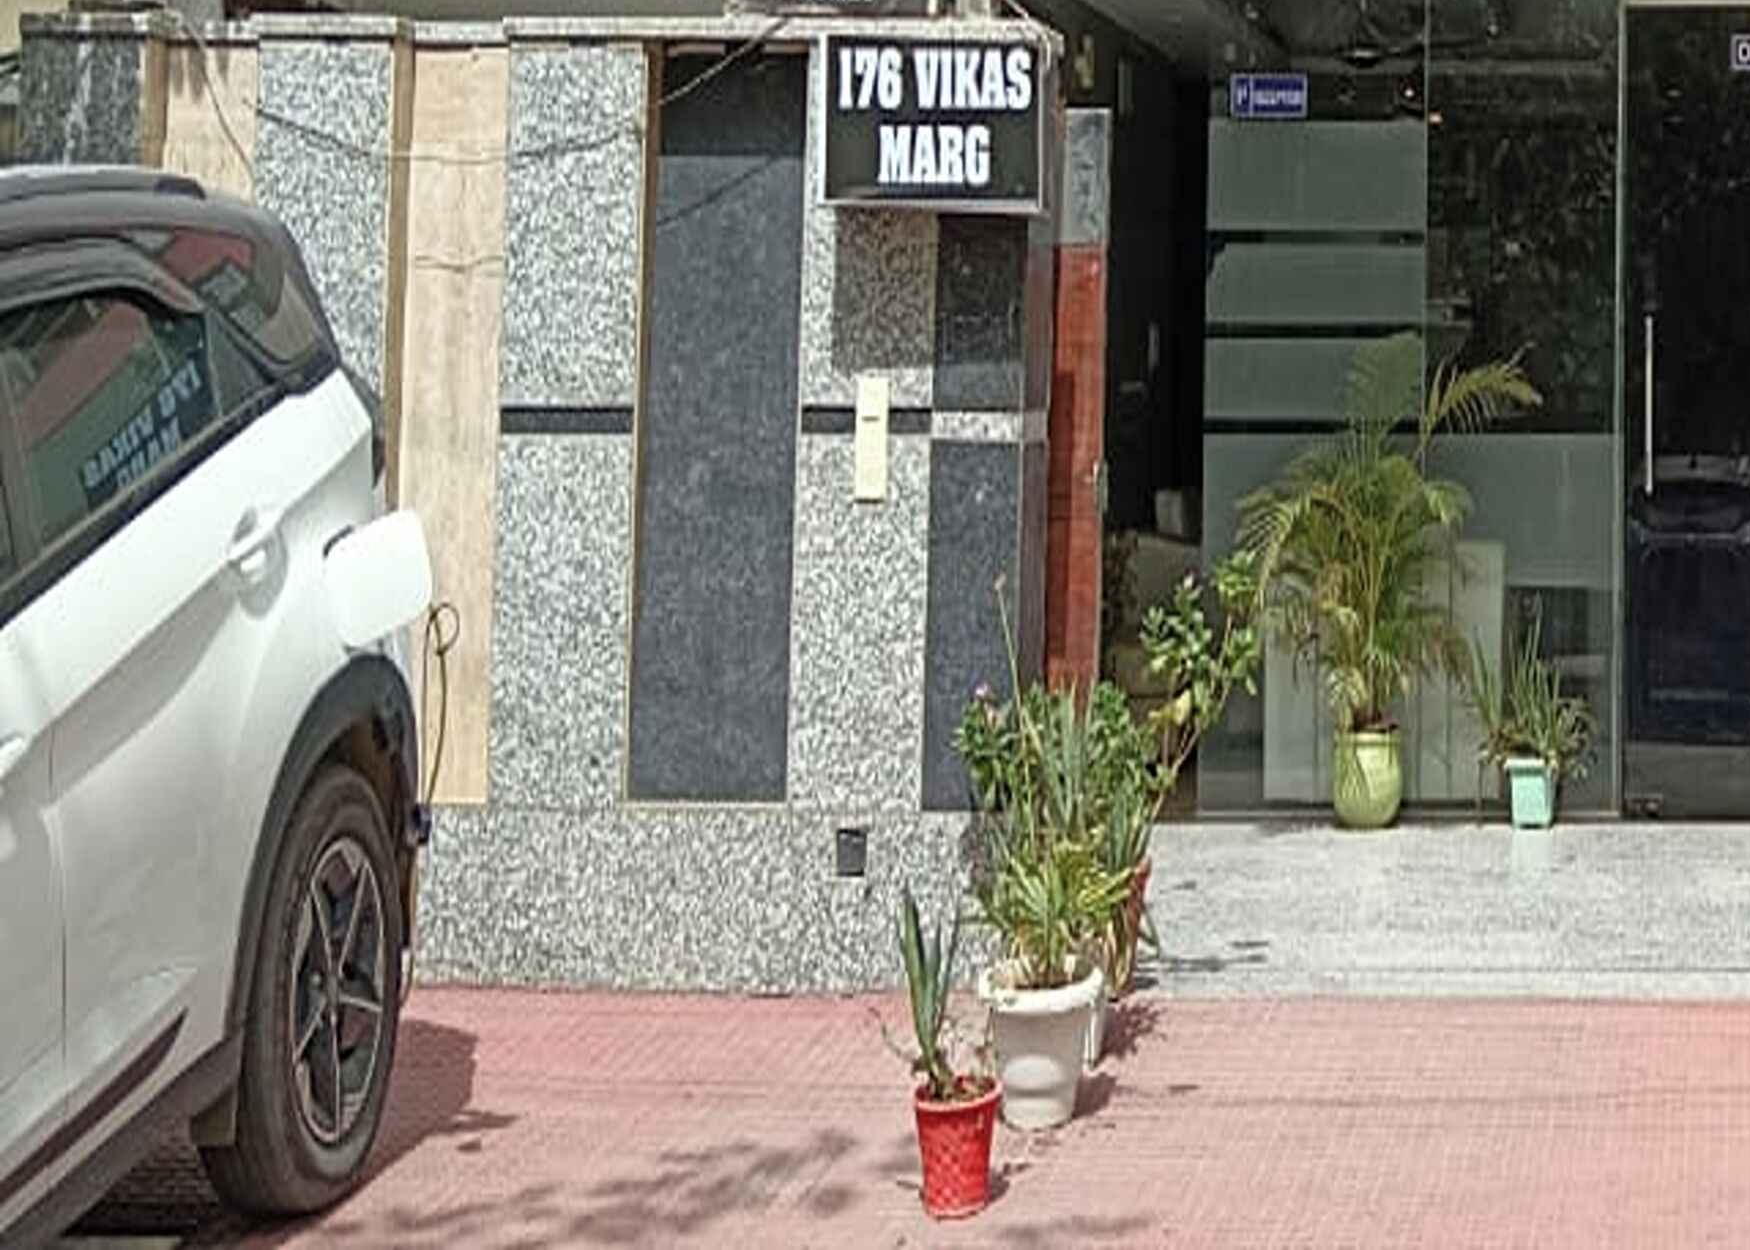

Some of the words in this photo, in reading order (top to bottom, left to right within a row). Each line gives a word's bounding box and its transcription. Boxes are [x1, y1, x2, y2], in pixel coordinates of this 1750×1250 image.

[838, 46, 903, 110] 176
[913, 47, 1033, 111] VIKAS
[876, 124, 993, 187] MARG
